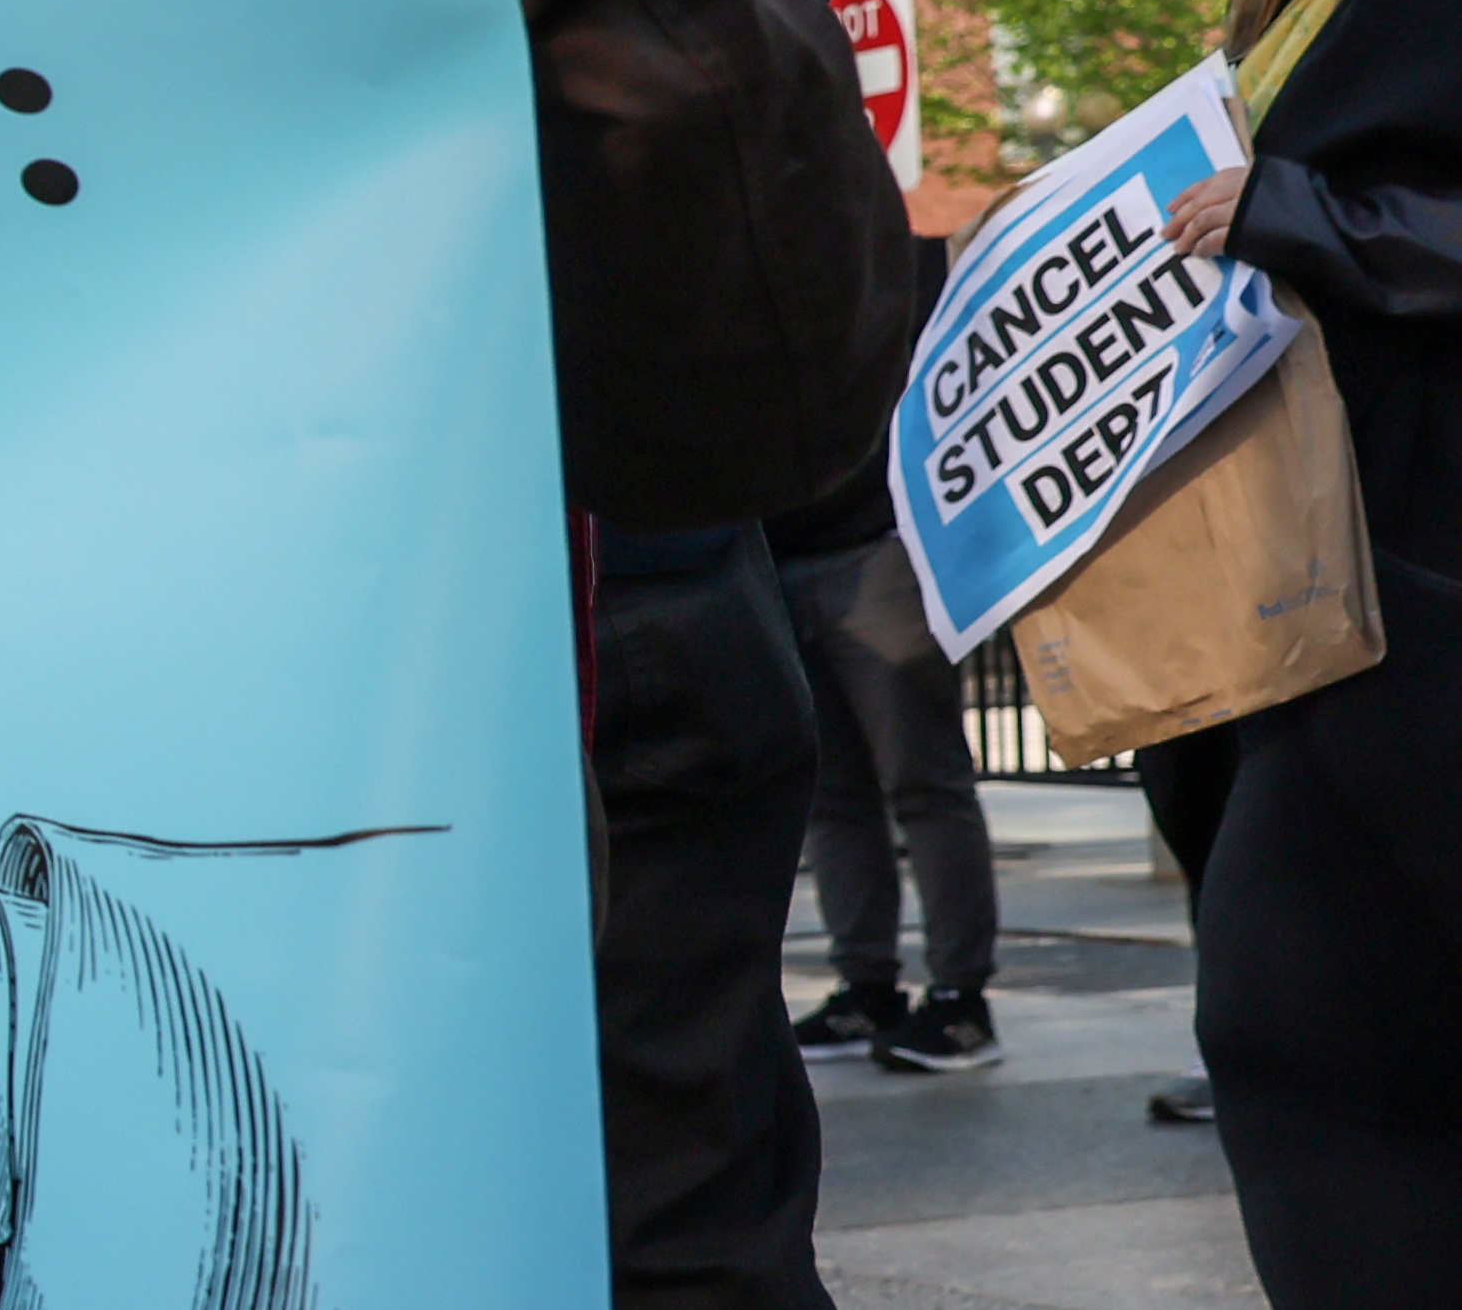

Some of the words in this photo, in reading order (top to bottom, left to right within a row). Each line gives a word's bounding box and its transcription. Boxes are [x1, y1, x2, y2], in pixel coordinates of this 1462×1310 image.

[932, 206, 1155, 418] CANCEL
[936, 251, 1207, 504] STUDENT
[1020, 362, 1174, 529] DEBT
